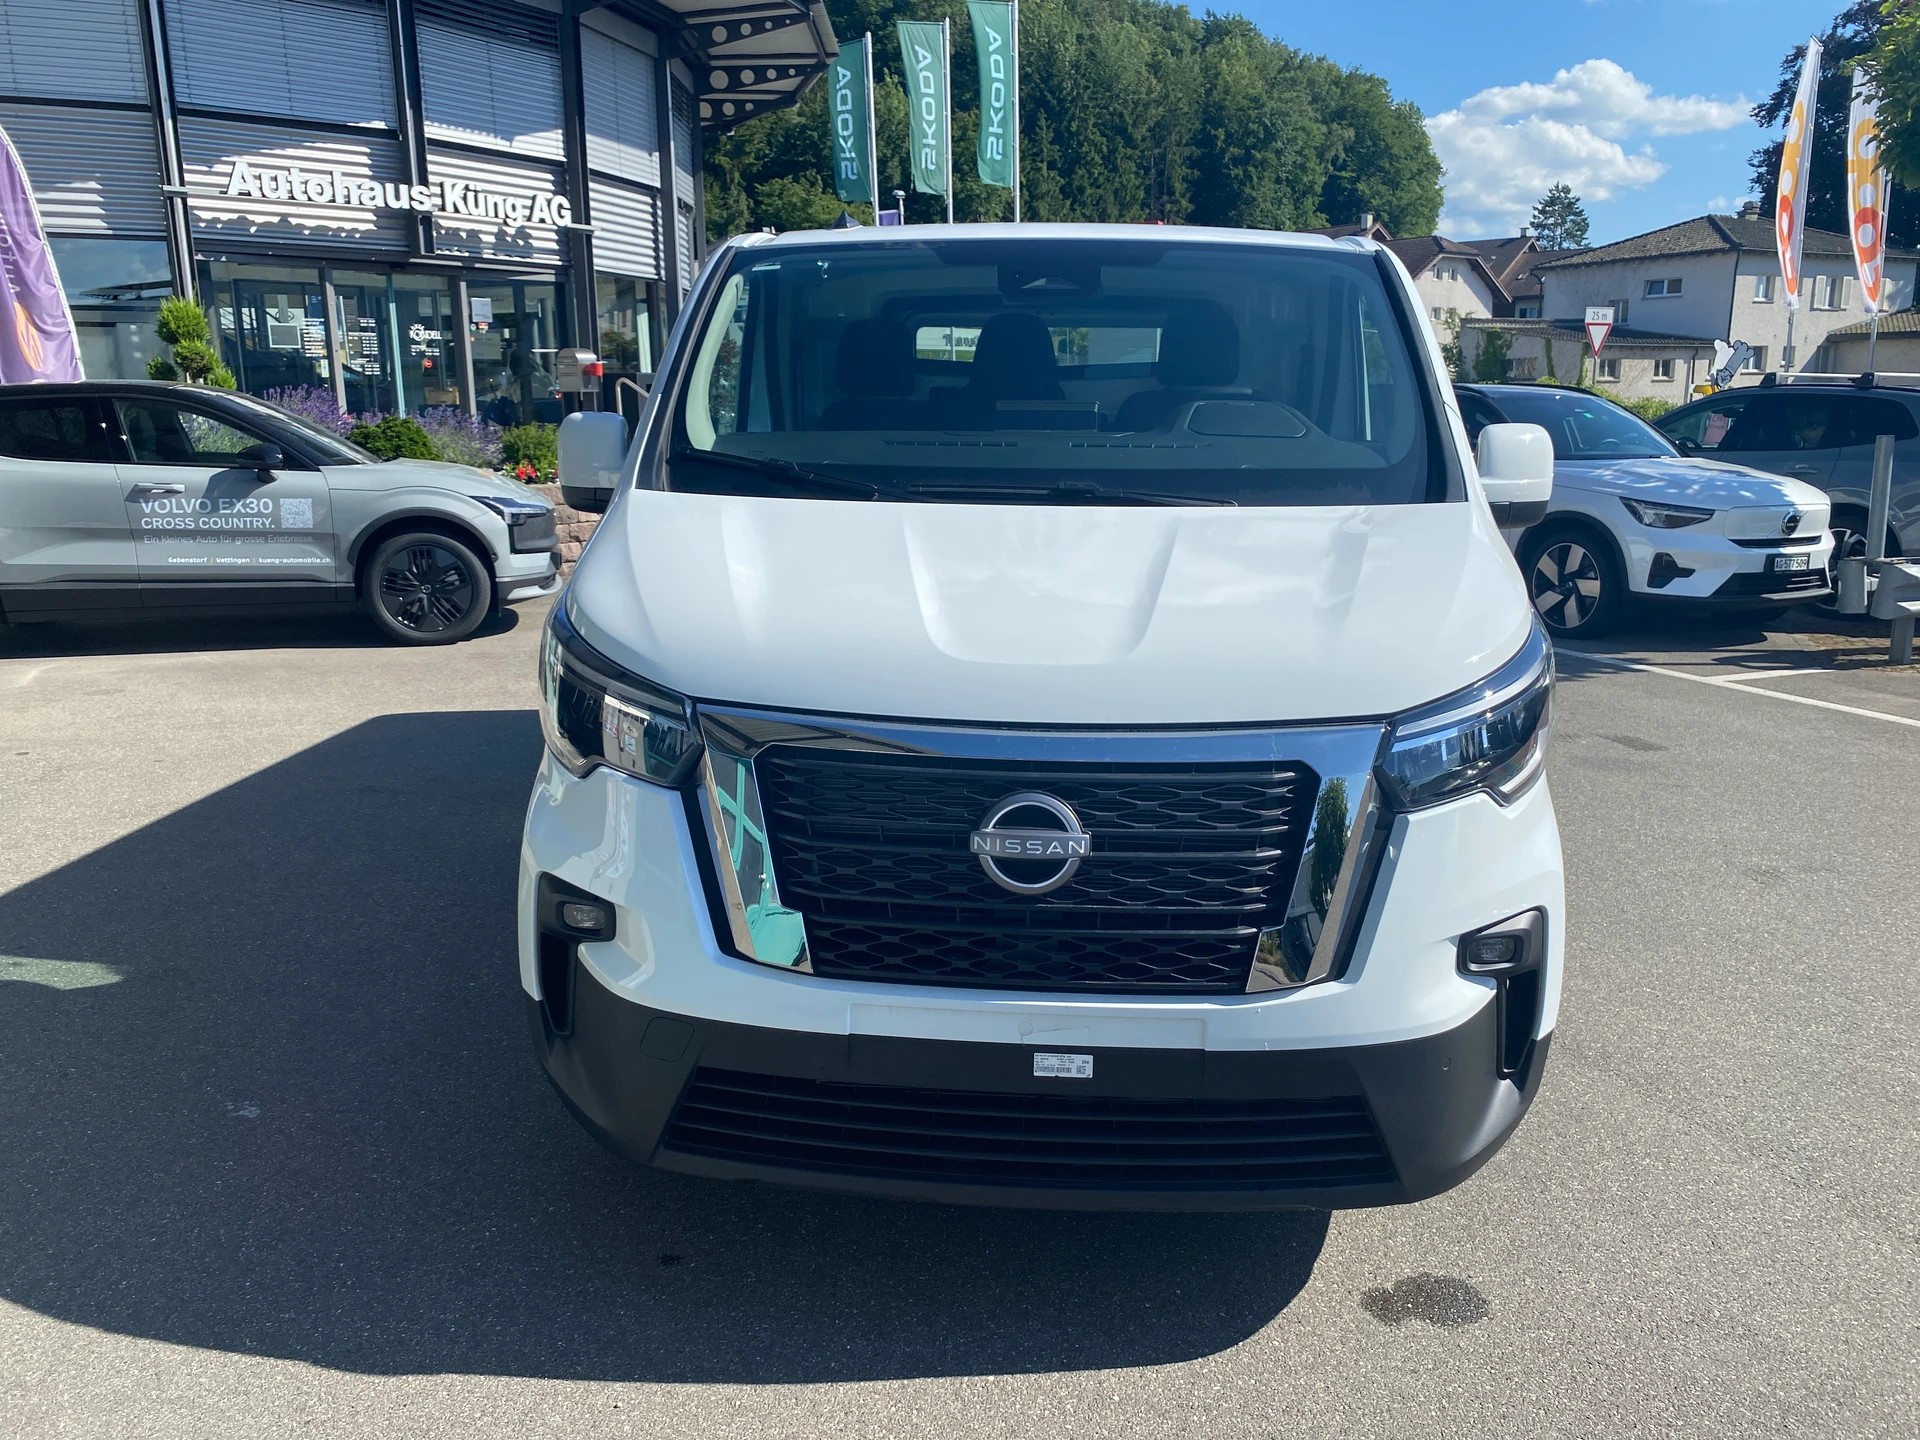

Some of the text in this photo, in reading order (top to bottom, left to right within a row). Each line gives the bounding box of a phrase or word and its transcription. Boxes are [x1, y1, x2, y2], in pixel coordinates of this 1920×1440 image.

[226, 160, 572, 227] Autohaus Küng AG
[1591, 311, 1608, 321] 25 m
[139, 498, 273, 515] VOLVO EX30
[141, 517, 275, 529] CROSS COUNTRY.
[144, 534, 316, 545] Ein kleines Auto für grosse Erlebnisse.
[168, 556, 331, 565] Gebenstorf Wettingen kueng-automobile.ch
[973, 834, 1086, 855] NISSAN
